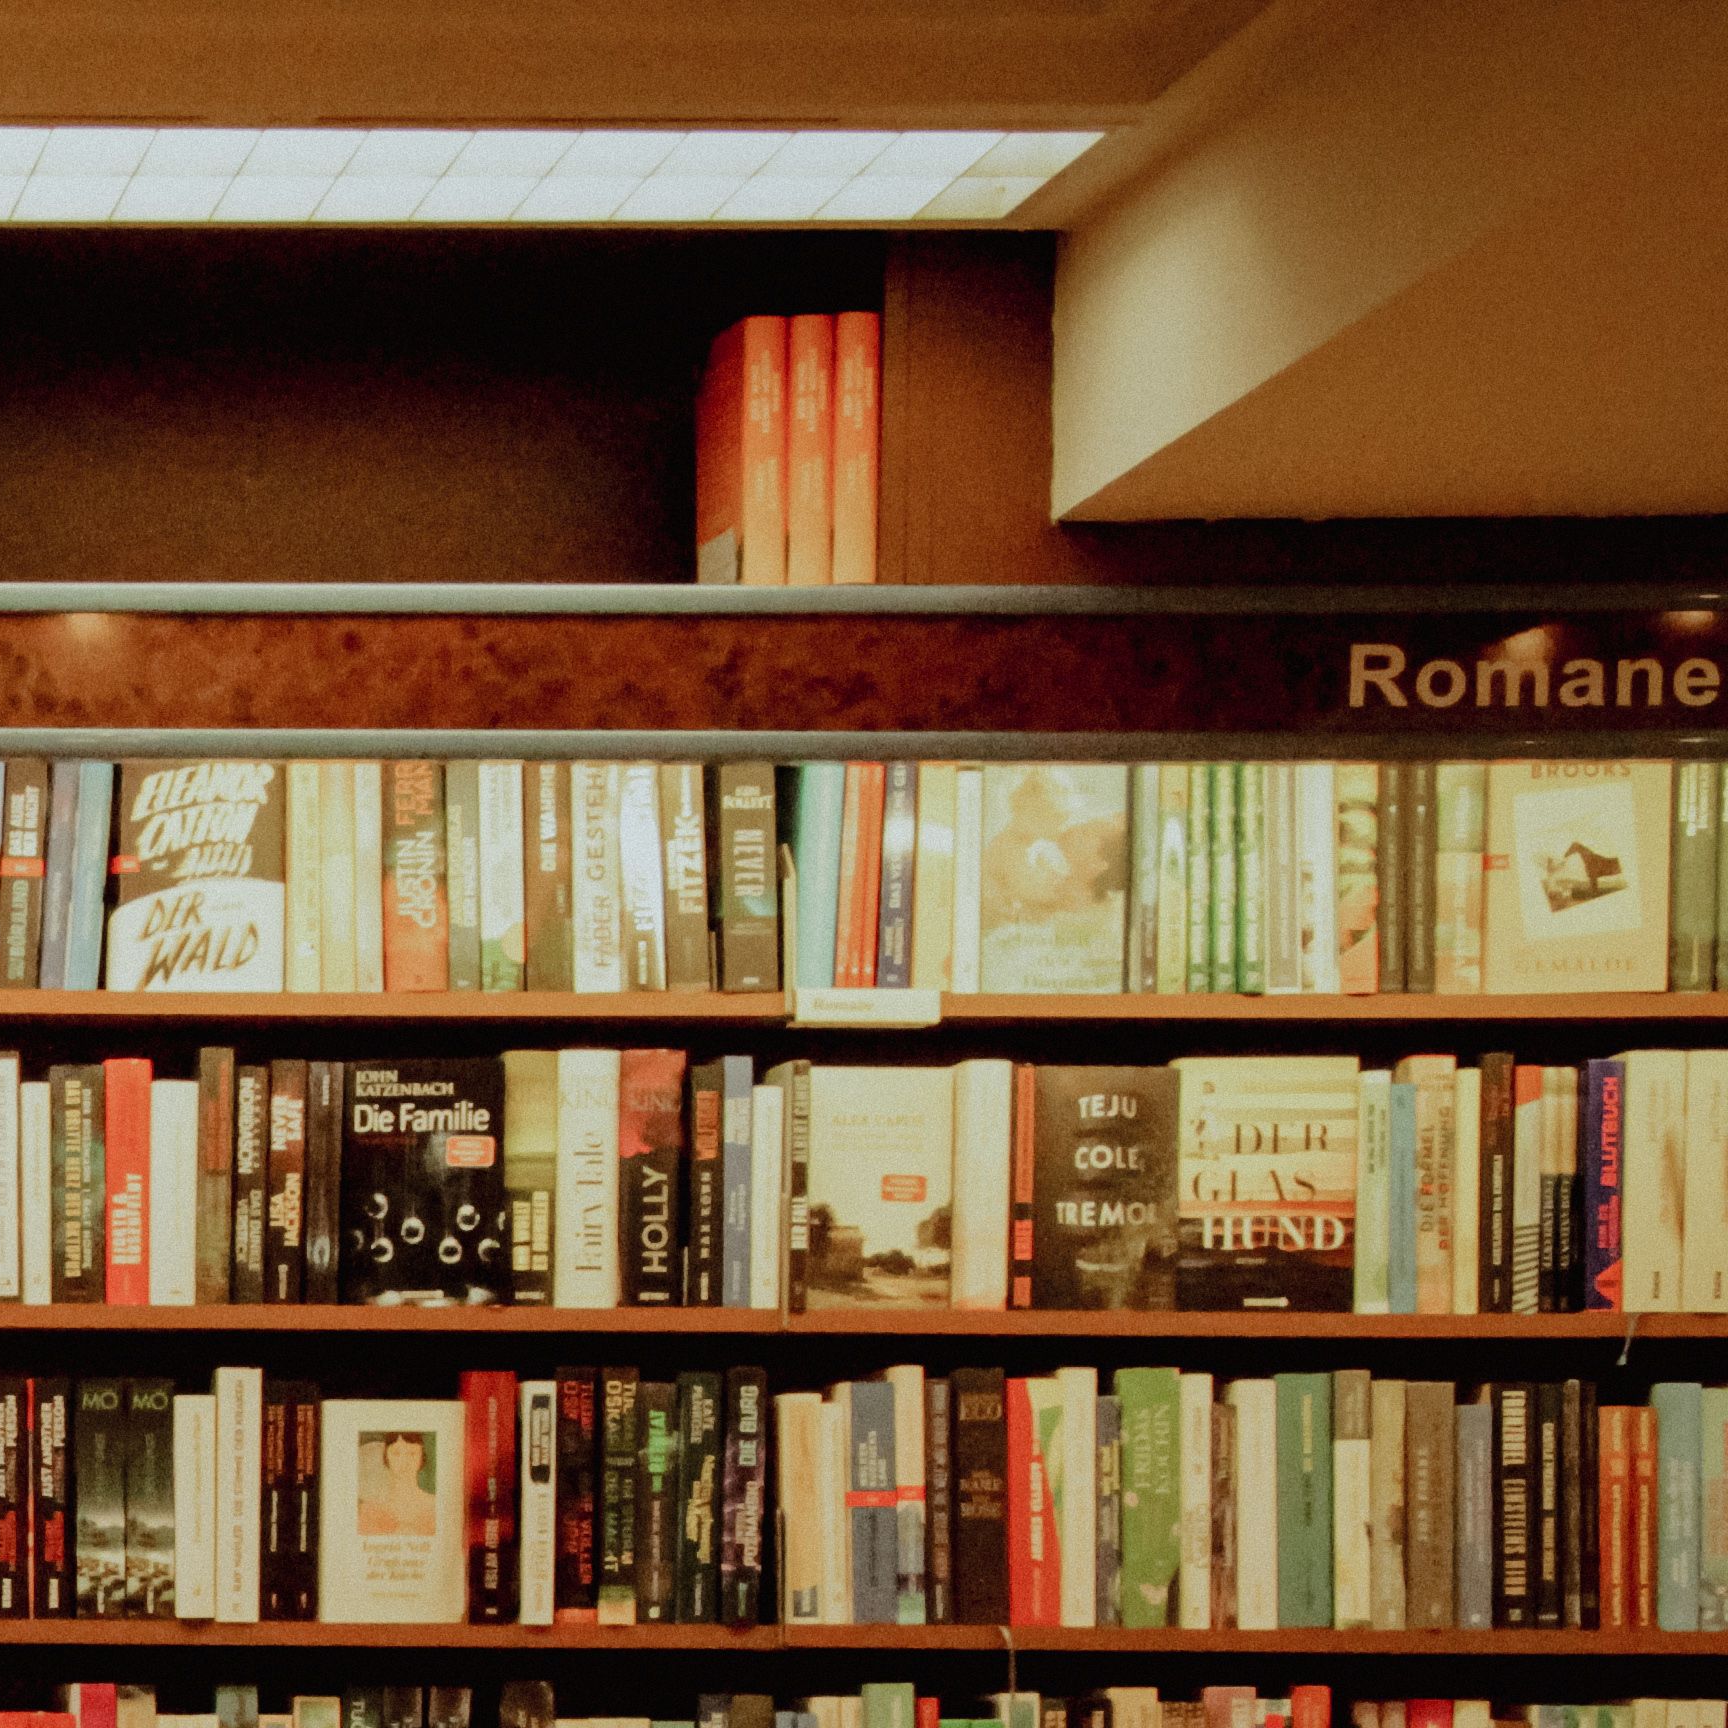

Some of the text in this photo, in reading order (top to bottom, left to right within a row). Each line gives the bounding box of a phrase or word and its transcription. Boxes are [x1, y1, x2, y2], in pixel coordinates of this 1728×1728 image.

[1348, 643, 1720, 709] Romane
[395, 838, 416, 916] JUSTIN
[411, 829, 437, 925] CRONIN
[135, 924, 260, 992] WALD
[352, 1101, 490, 1133] Die Familie
[1077, 1095, 1137, 1119] TEJU
[1601, 1077, 1619, 1188] BLUTBUCH
[1073, 1145, 1140, 1170] COLE
[1234, 1123, 1329, 1154] DER
[1190, 1170, 1317, 1202] GLAS
[641, 1166, 669, 1274] HOLLY
[1201, 1217, 1346, 1252] HUND
[5, 1394, 17, 1447] PERSON
[53, 1394, 65, 1447] PERSON
[739, 1385, 759, 1433] BURG
[41, 1402, 53, 1497] JUST ANOTHER
